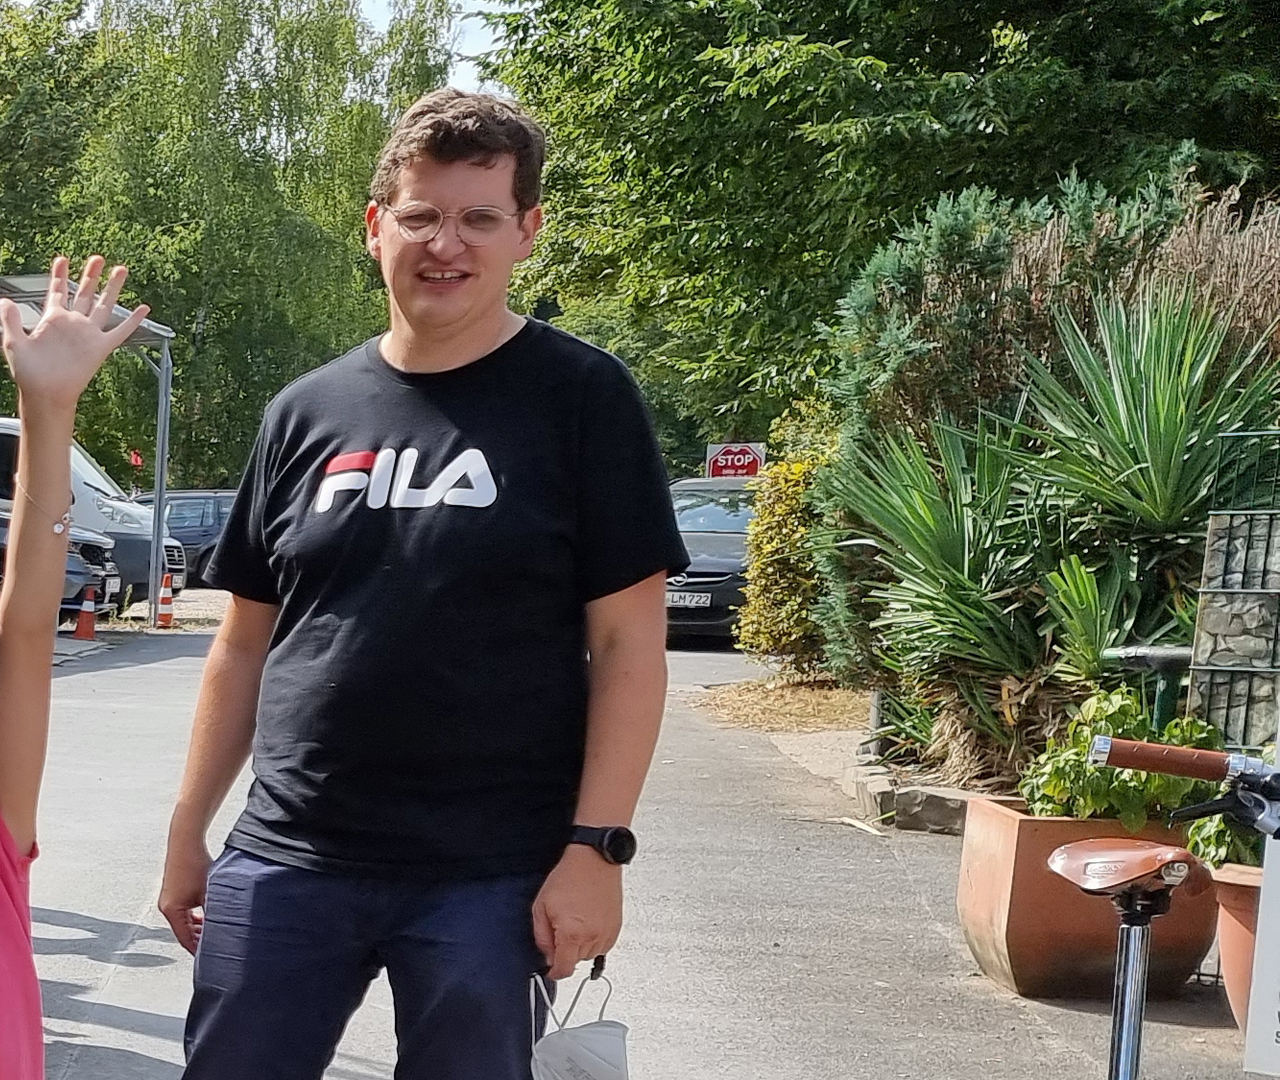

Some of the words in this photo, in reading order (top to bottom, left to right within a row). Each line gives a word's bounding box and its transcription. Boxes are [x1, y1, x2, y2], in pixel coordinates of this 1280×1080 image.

[717, 454, 754, 466] STOP
[315, 448, 498, 514] FILA
[671, 594, 686, 604] LM
[688, 595, 710, 605] 722
